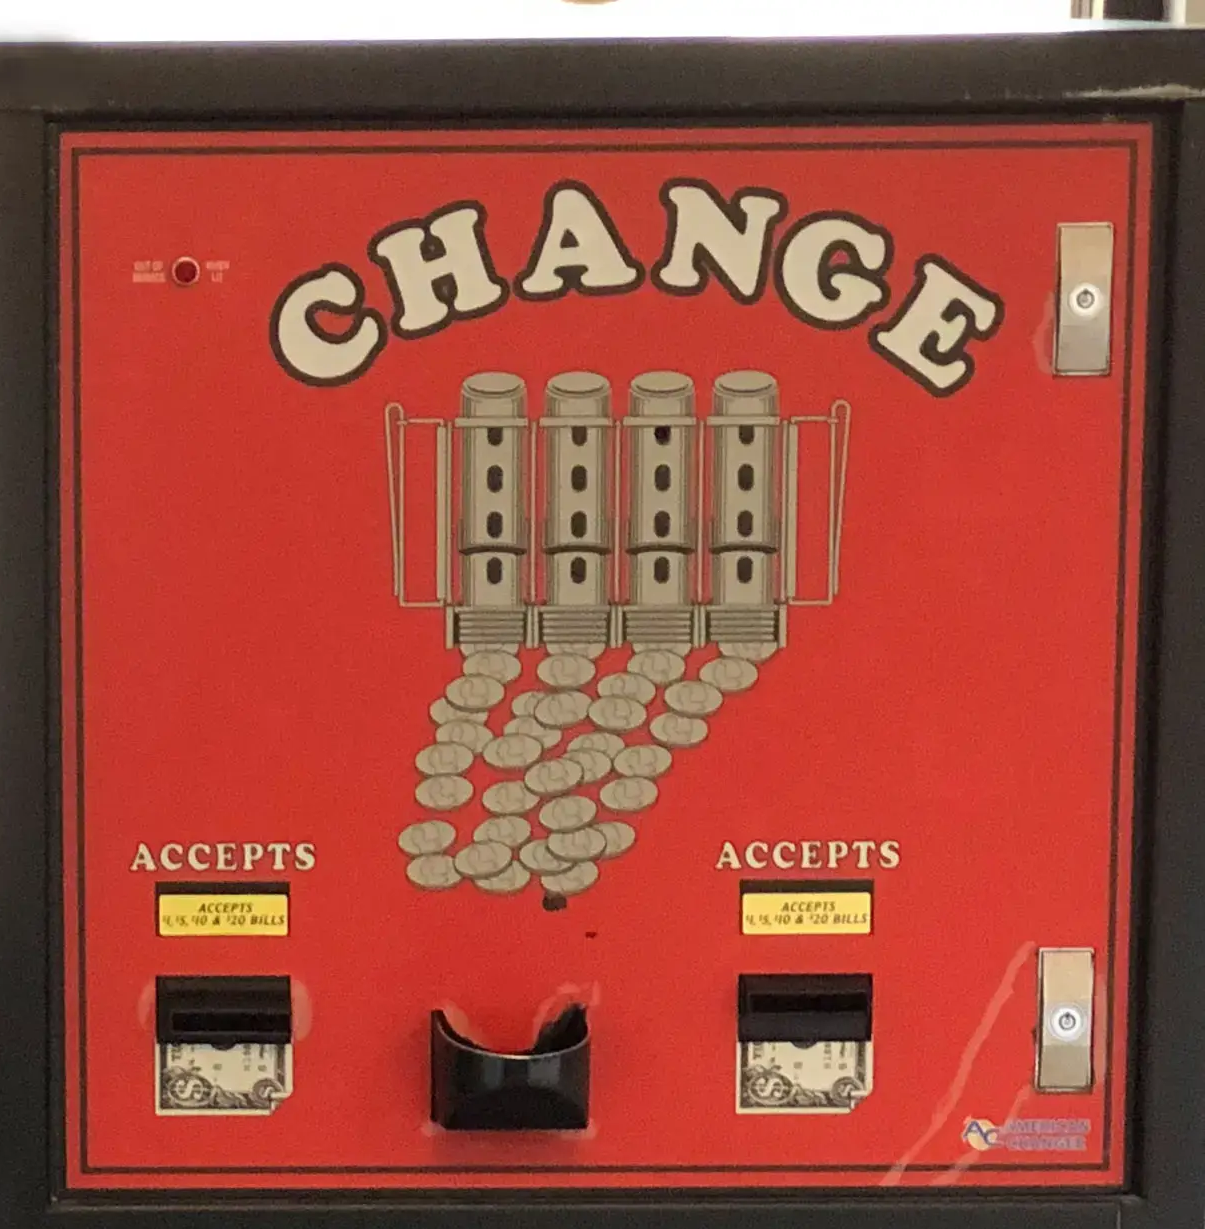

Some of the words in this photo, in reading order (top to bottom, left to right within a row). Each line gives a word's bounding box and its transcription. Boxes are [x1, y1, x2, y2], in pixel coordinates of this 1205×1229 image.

[269, 178, 1005, 398] CHANGE
[130, 842, 316, 871] ACCEPTS
[716, 841, 900, 869] ACCEPTS
[198, 903, 254, 913] ACCEPTS
[781, 901, 836, 912] ACCEPTS
[211, 915, 221, 926] &
[249, 914, 285, 926] BILLS
[794, 914, 804, 925] &
[832, 913, 868, 925] BILLS
